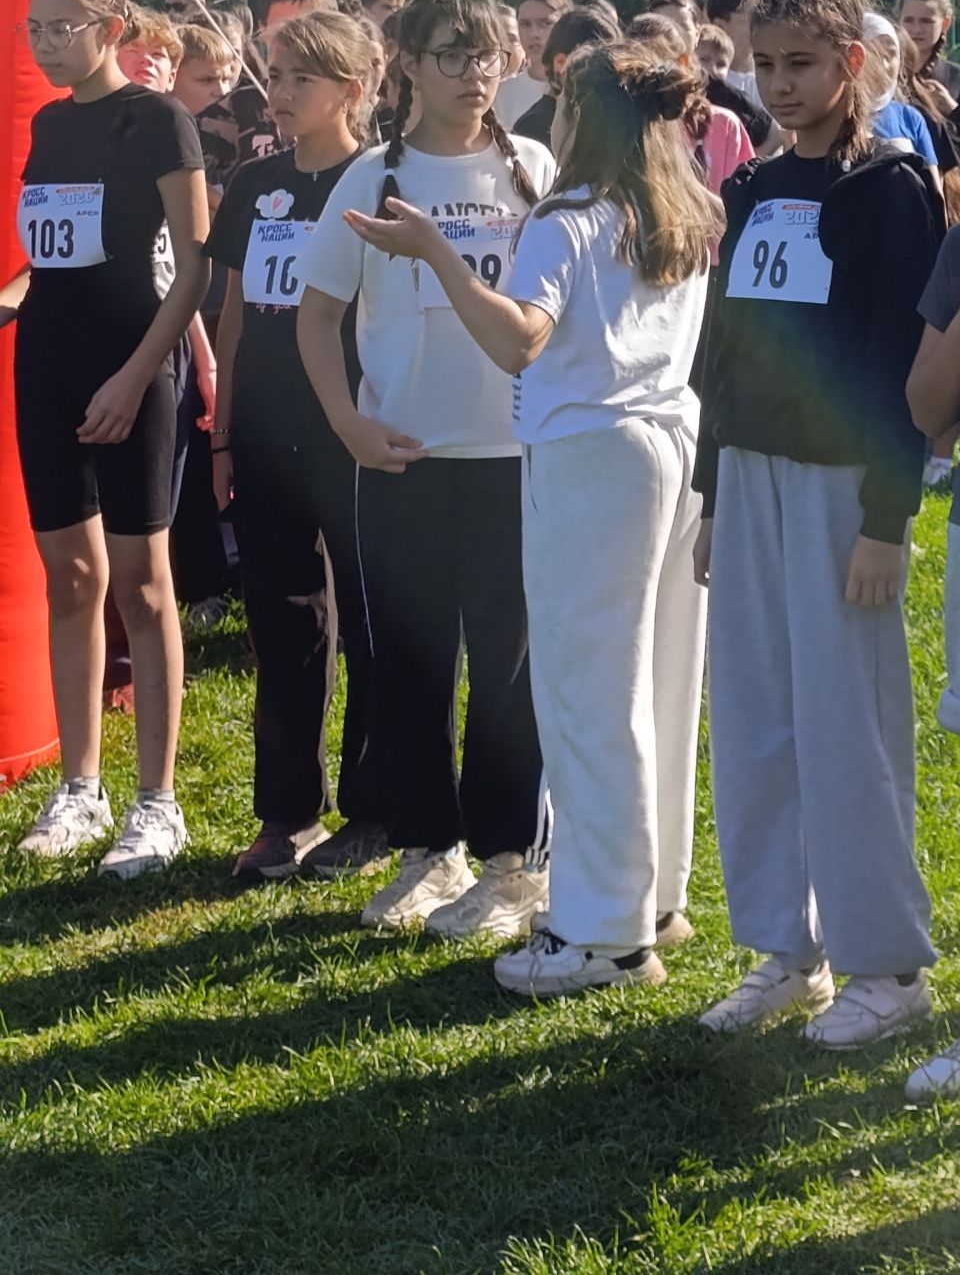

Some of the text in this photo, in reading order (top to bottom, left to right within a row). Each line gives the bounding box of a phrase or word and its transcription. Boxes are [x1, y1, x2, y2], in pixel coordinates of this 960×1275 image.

[22, 186, 46, 200] КРОСС
[24, 195, 48, 208] НАЦИИ
[437, 218, 471, 231] РОСС
[785, 210, 819, 226] 202
[257, 223, 293, 235] КРОСС
[28, 218, 74, 259] 103
[261, 231, 295, 243] НАЦИИ
[752, 239, 788, 289] 96
